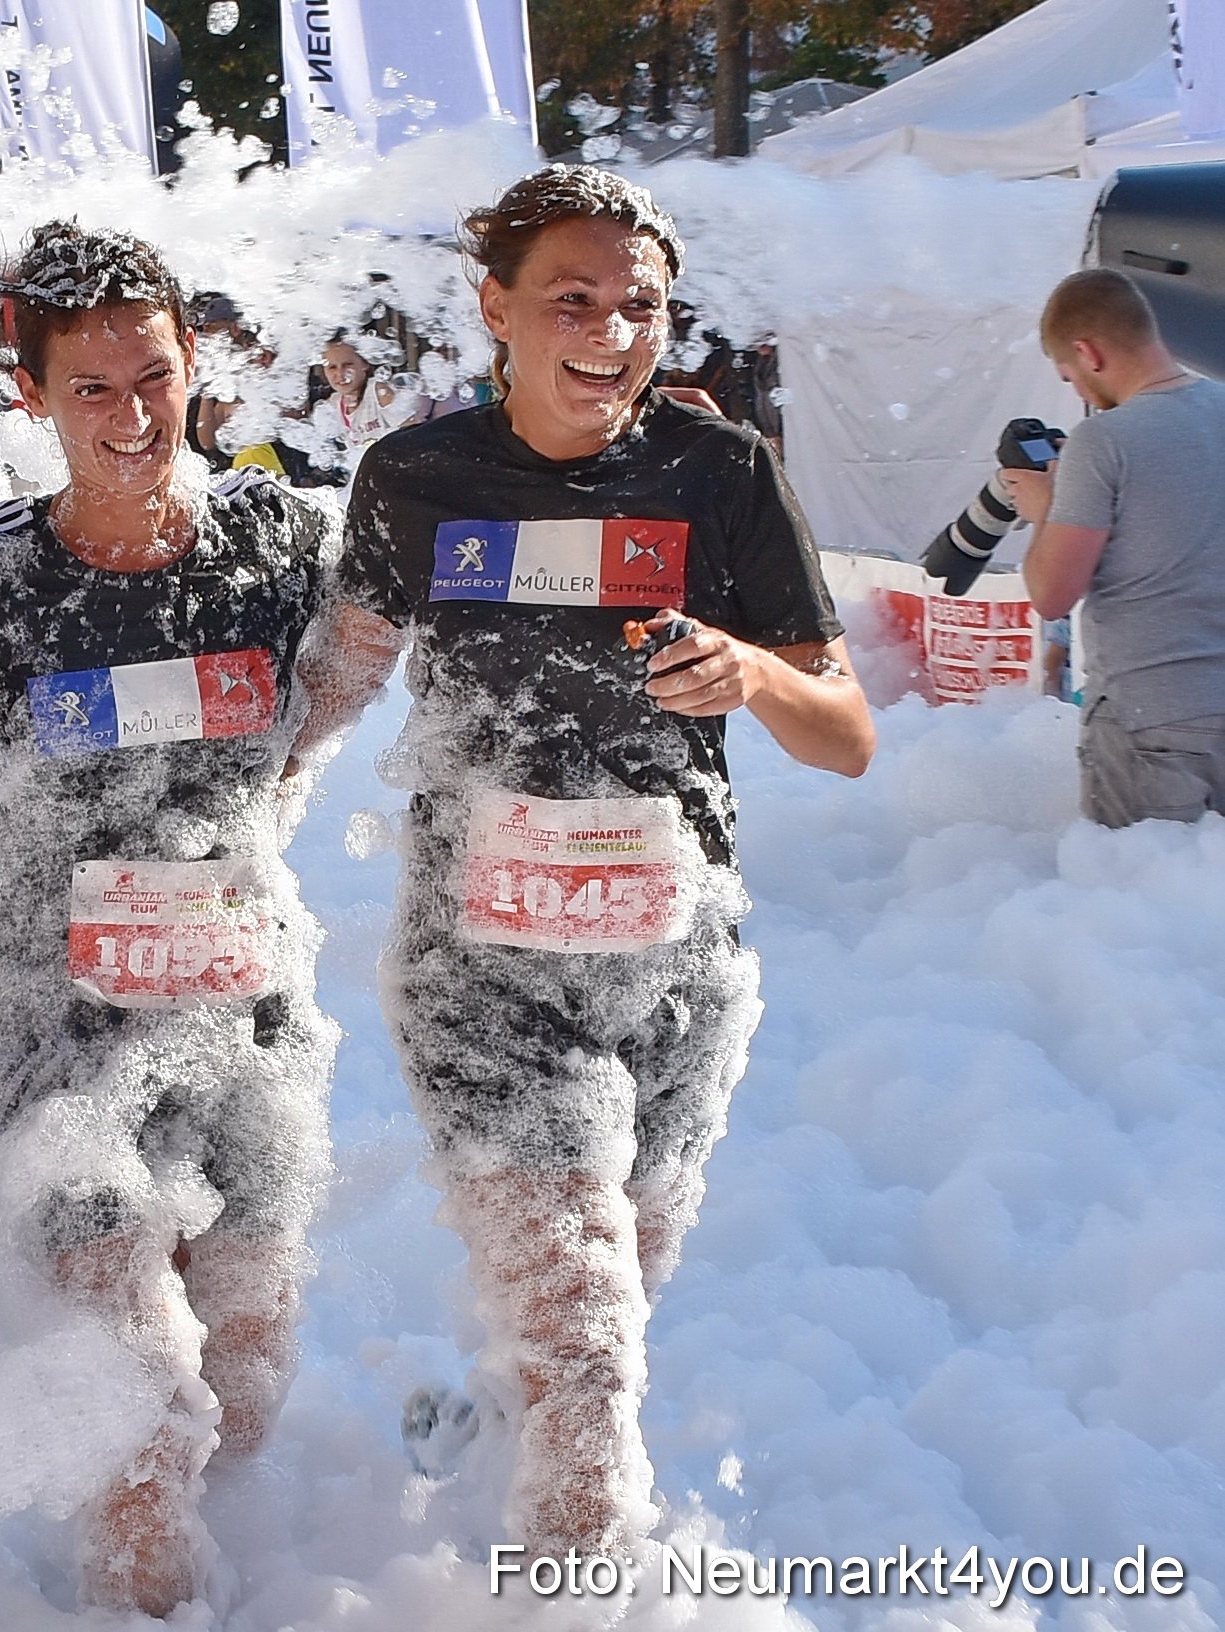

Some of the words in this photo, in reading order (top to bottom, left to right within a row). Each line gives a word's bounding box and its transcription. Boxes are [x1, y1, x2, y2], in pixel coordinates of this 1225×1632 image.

[433, 578, 505, 589] PEUGEOT
[567, 829, 643, 841] NEUMARKTER
[492, 870, 649, 920] 1045
[131, 903, 158, 914] RUN
